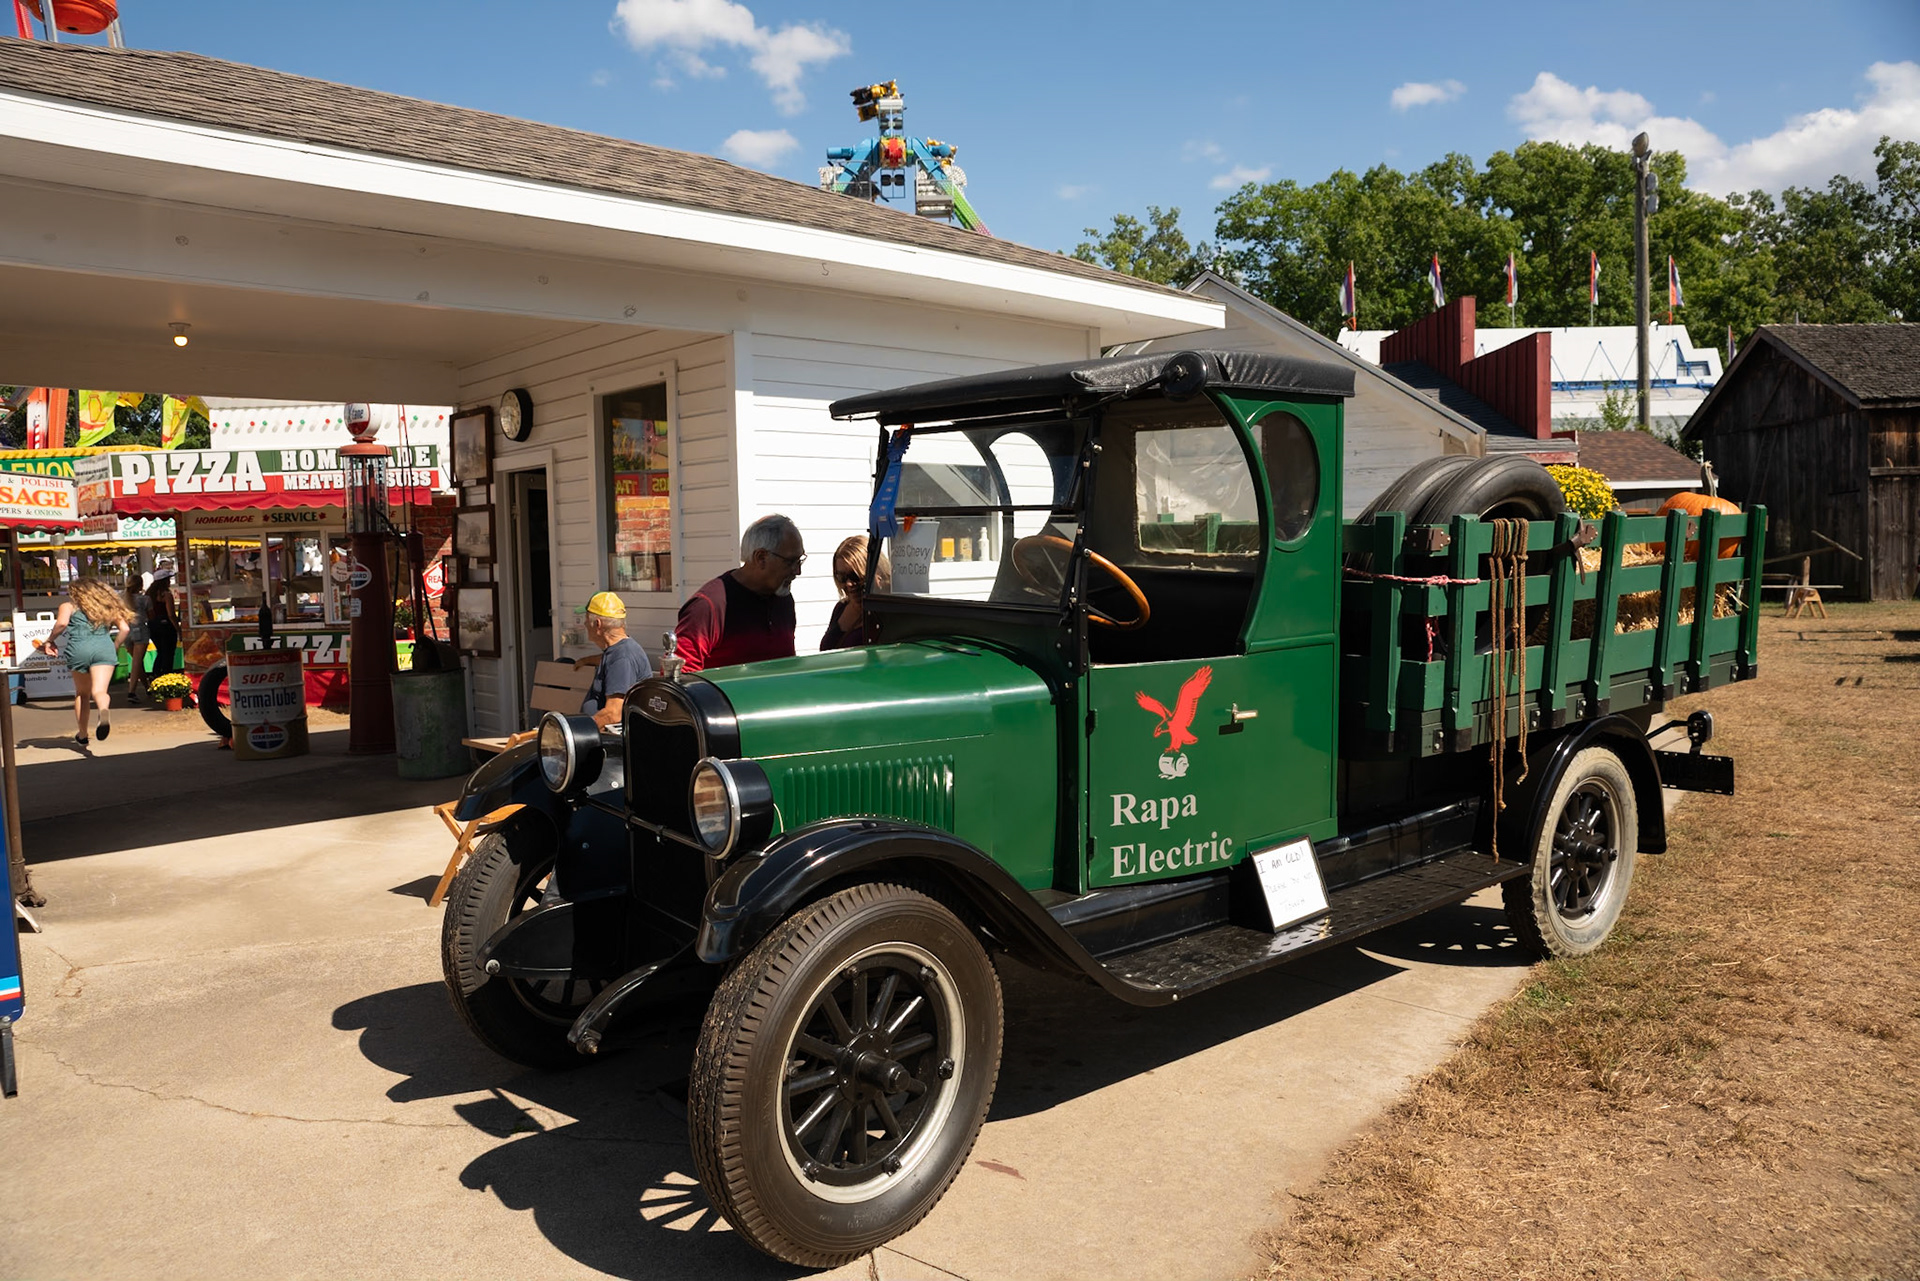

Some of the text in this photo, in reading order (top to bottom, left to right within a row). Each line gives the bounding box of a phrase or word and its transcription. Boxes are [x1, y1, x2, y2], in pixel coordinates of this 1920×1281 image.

[280, 446, 431, 471] HOMADE
[119, 451, 266, 495] PIZZA
[387, 471, 431, 487] SUBS
[21, 477, 64, 488] POLISH
[195, 512, 318, 525] HOMEMADE SERVICE
[122, 530, 153, 538] SINCE
[906, 544, 931, 561] Chevy
[914, 563, 927, 575] Cab
[242, 672, 285, 685] SUPER
[233, 687, 297, 709] Permalube
[1110, 793, 1198, 830] Rapa
[1110, 831, 1233, 878] Electric
[1257, 859, 1267, 875] I
[1271, 858, 1283, 870] AM
